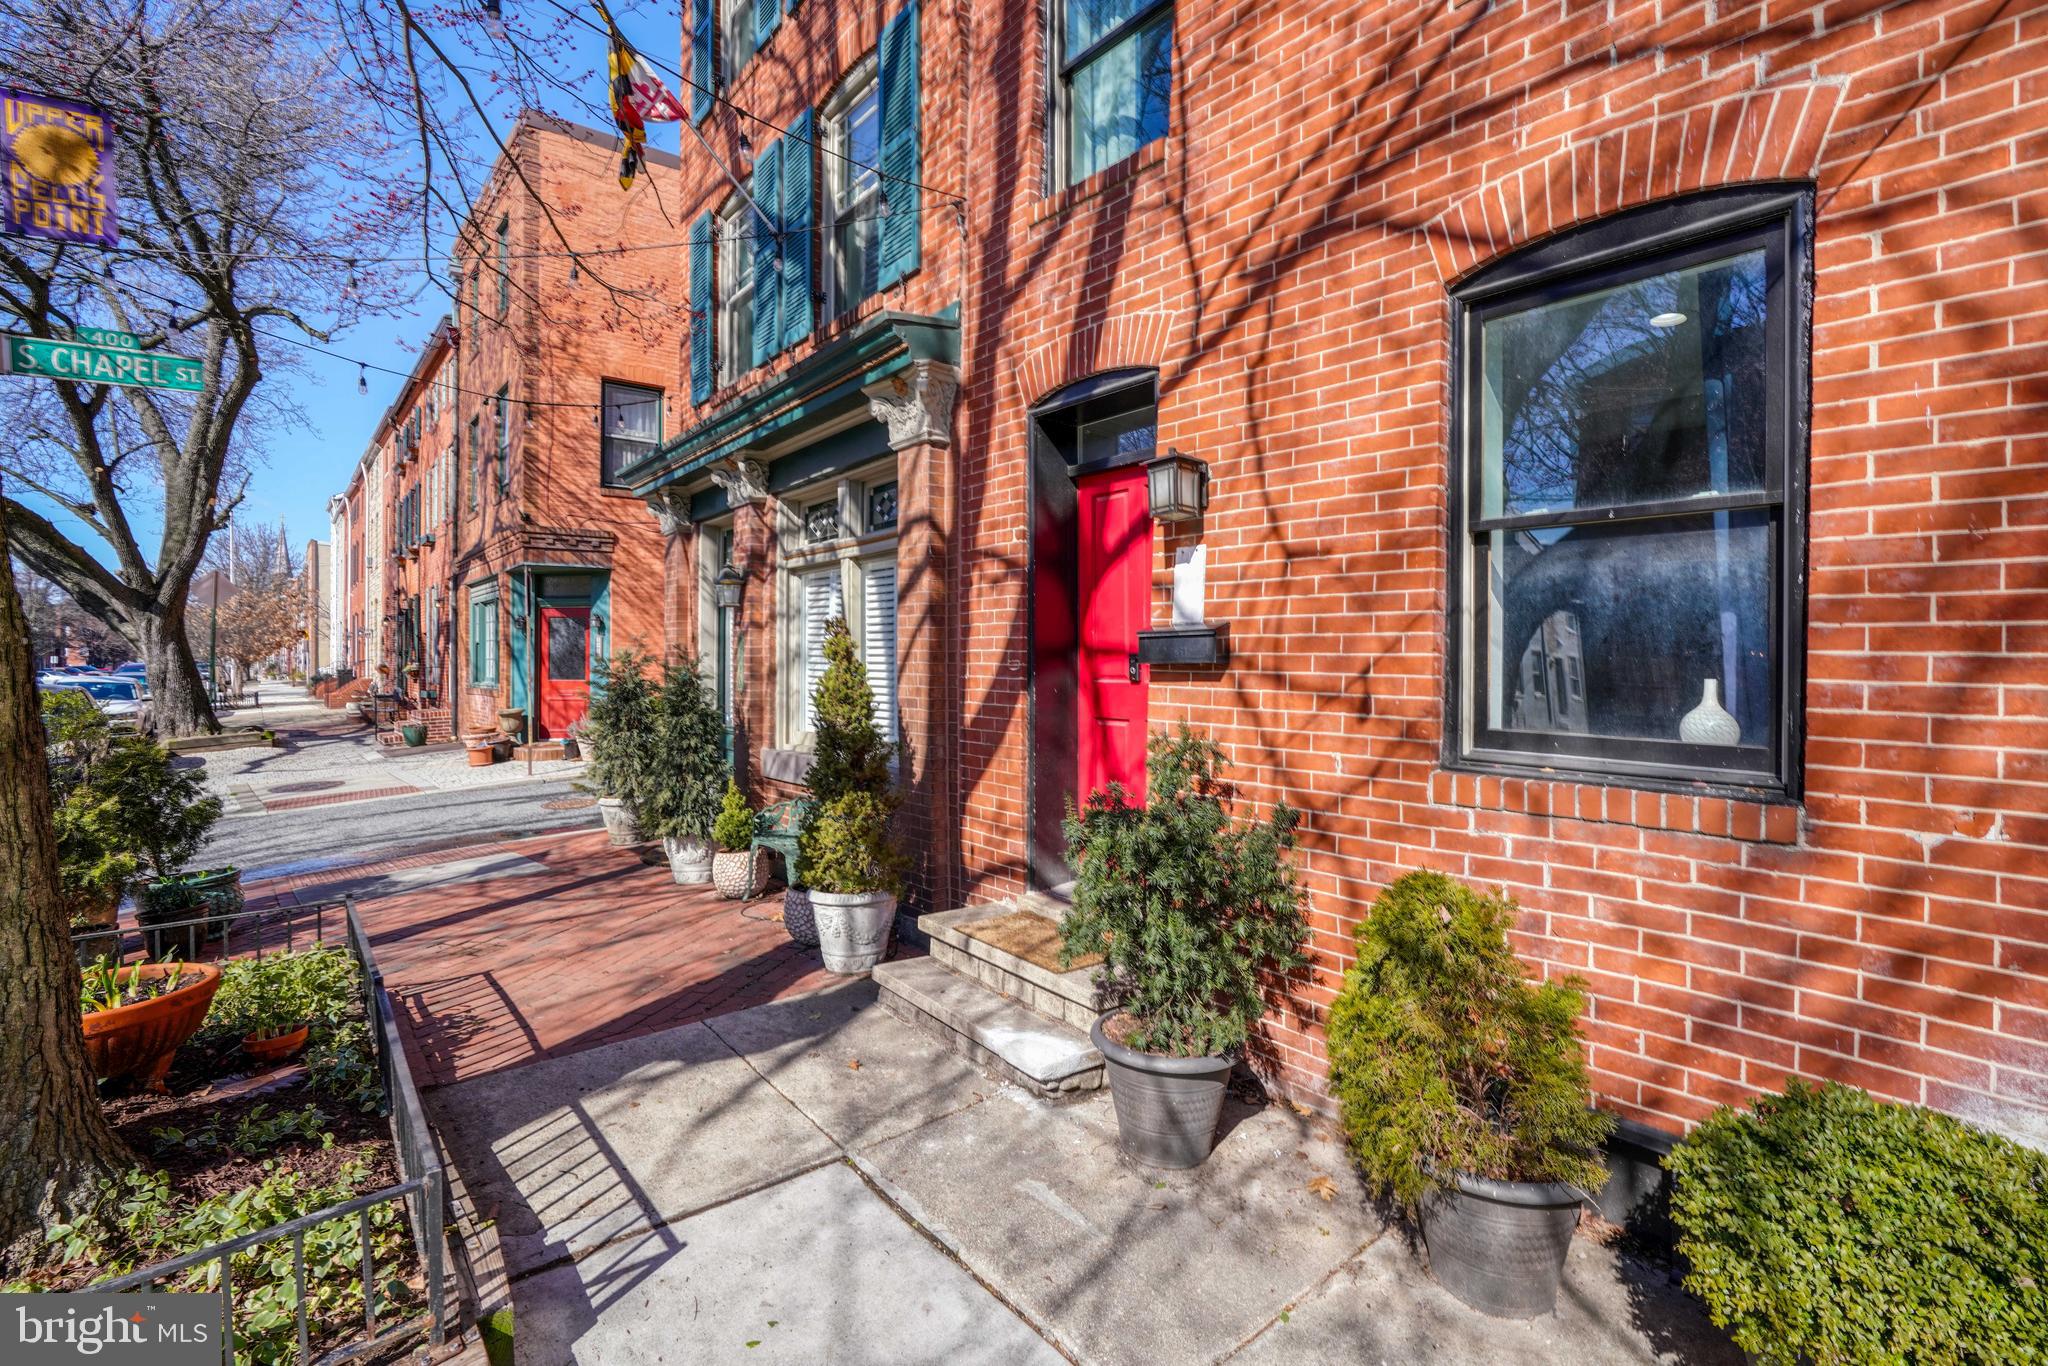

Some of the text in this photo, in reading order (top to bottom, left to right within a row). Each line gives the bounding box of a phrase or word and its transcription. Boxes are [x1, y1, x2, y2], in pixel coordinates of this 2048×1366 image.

[4, 98, 104, 151] UPPER
[10, 160, 106, 209] FELLS
[92, 332, 134, 348] 400
[18, 344, 43, 370] S.
[51, 348, 168, 385] CHAPEL
